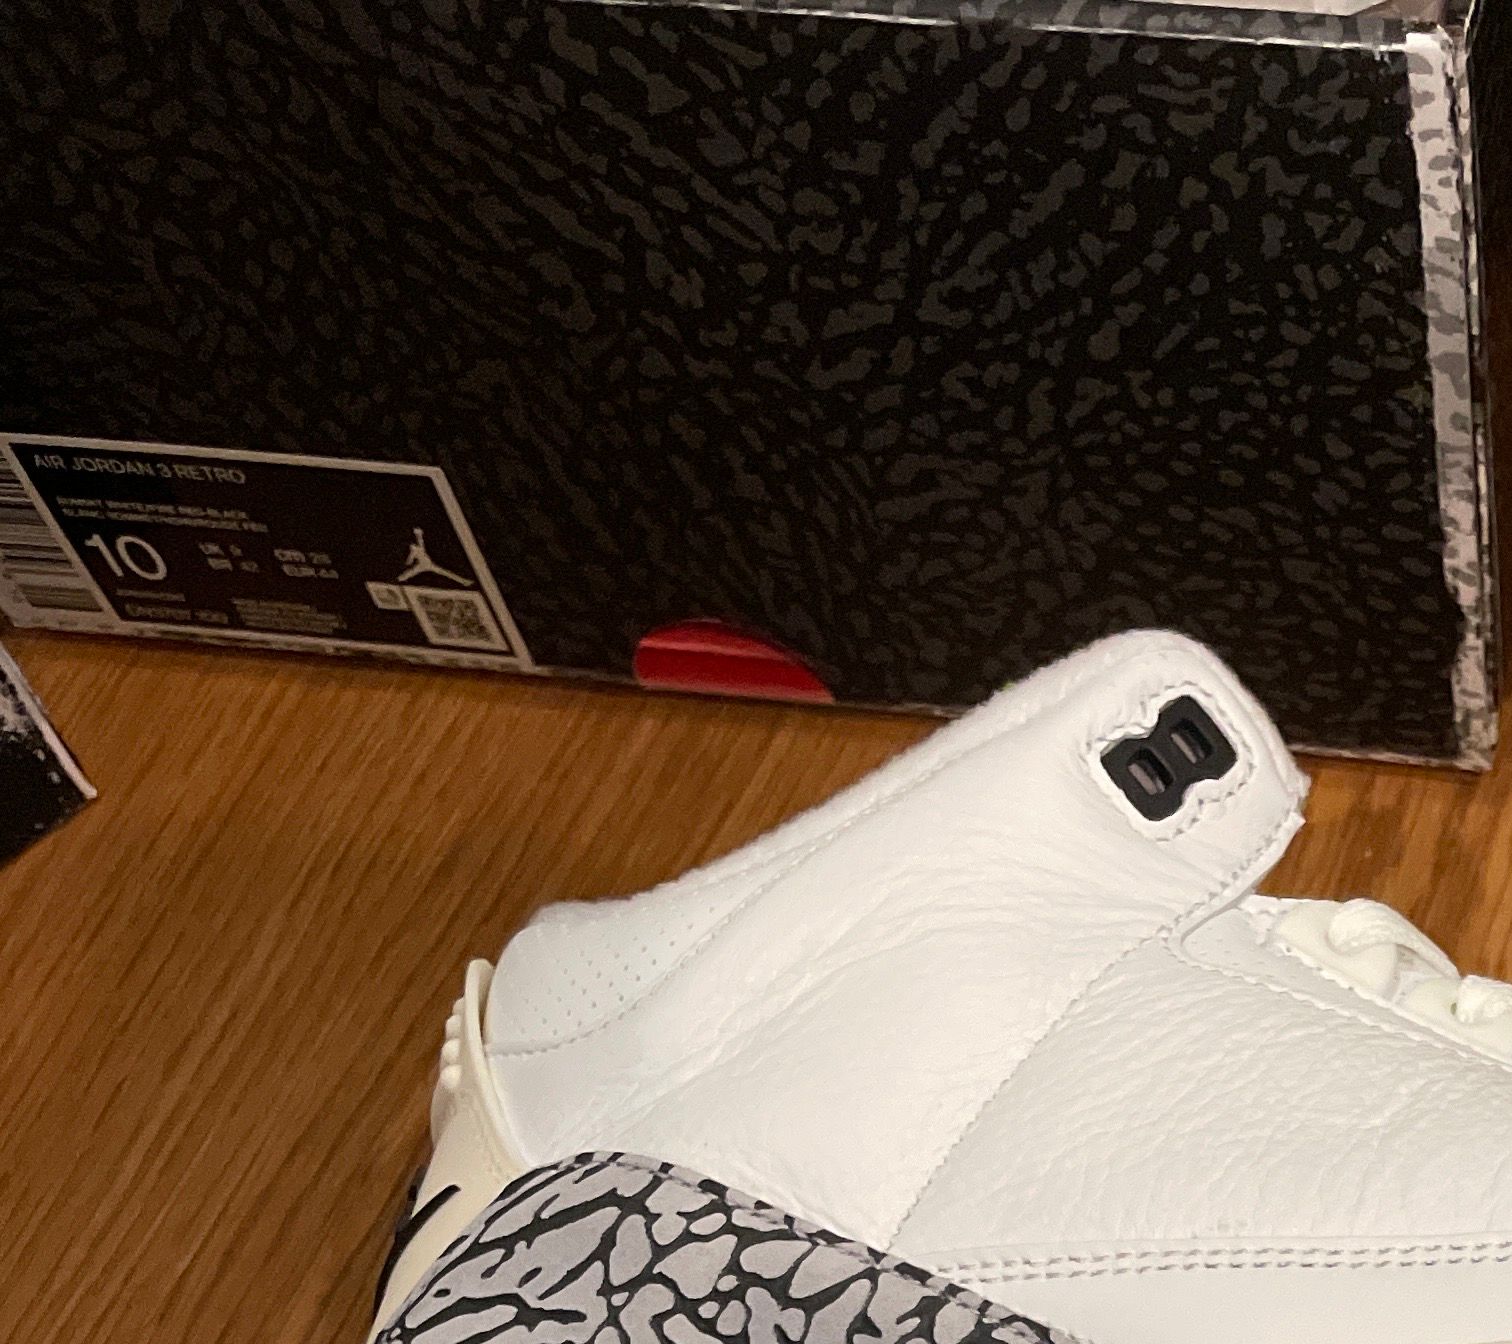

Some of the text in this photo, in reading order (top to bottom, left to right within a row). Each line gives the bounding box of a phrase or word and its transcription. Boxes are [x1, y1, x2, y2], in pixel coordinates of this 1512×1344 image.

[34, 454, 246, 484] AIR JORDAN 3 RETRO
[84, 533, 168, 581] 10
